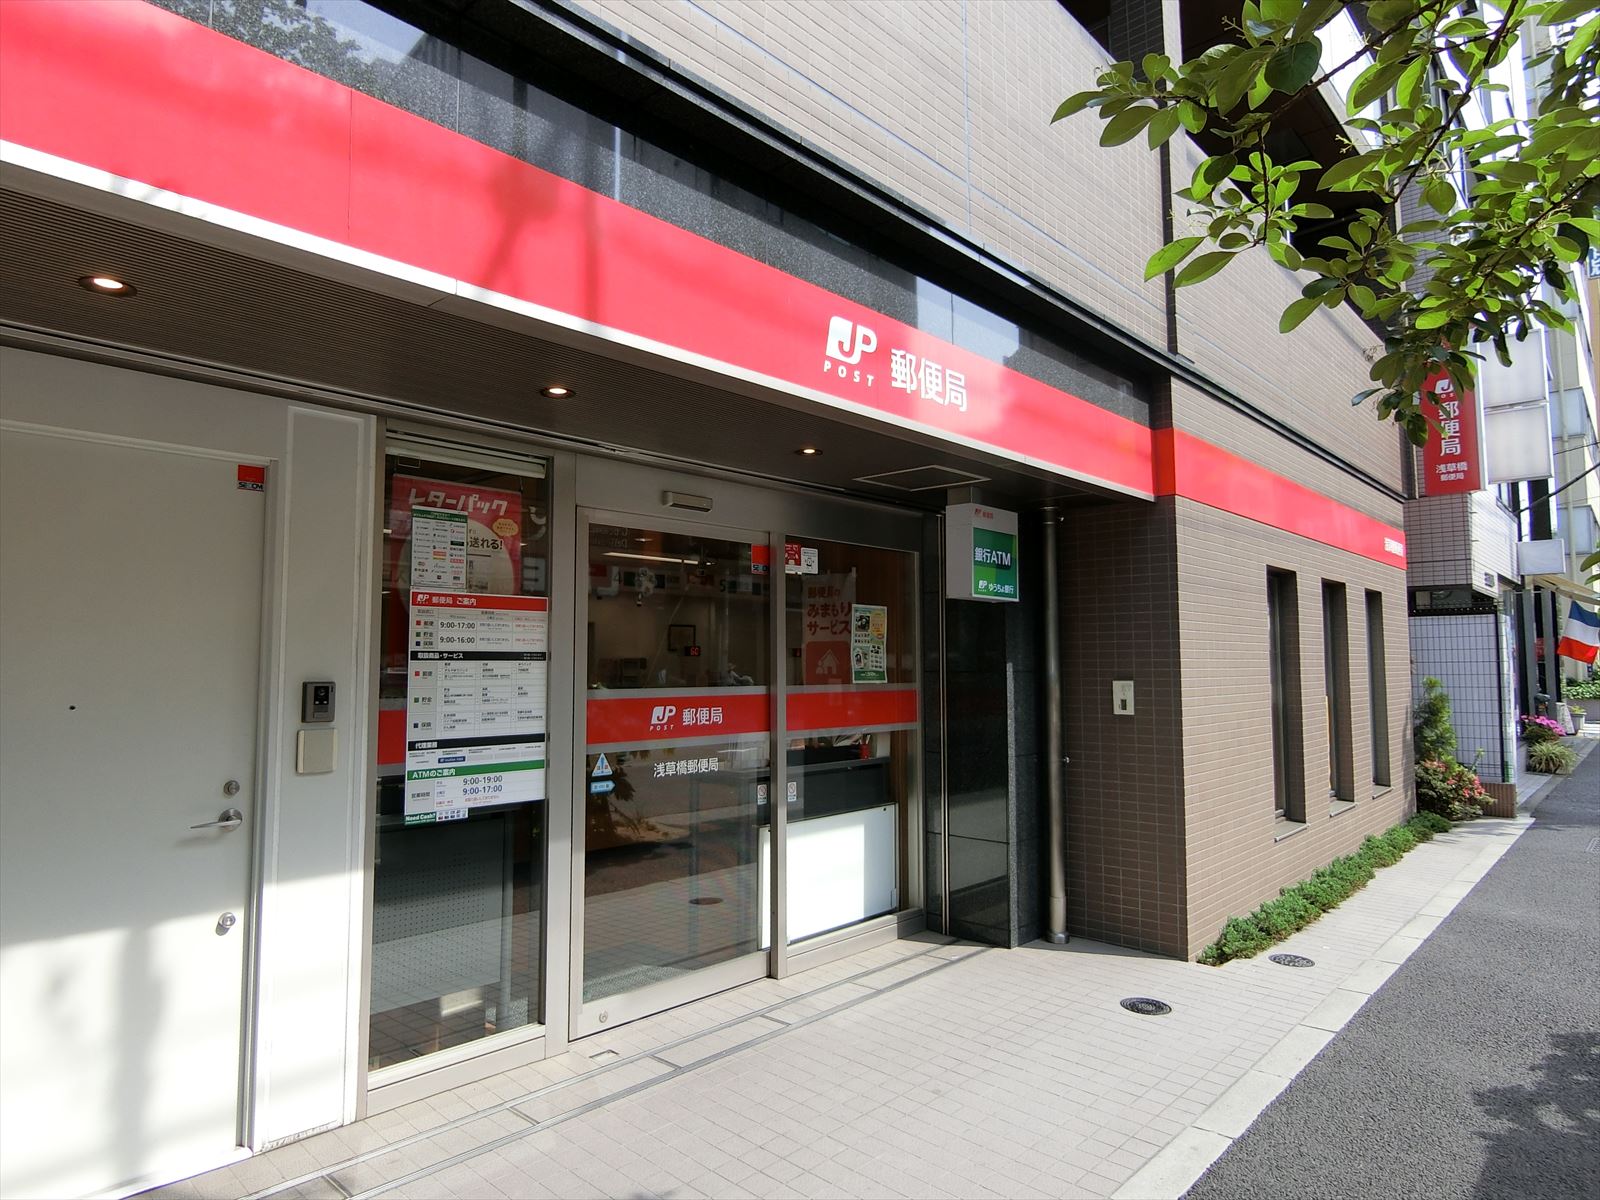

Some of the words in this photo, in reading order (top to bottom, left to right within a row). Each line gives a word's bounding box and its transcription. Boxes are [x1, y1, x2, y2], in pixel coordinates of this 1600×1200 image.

[825, 315, 878, 365] JP
[890, 348, 968, 412] 郵便局
[823, 360, 875, 387] POST
[408, 487, 508, 516] レターパック
[467, 536, 503, 550] 送れる!
[974, 546, 1011, 567] 銀行ATM
[988, 583, 1014, 594] ゆうちょ銀行
[807, 601, 852, 618] みまもり
[440, 621, 476, 630] 9:00-17:00
[807, 619, 851, 636] サービス
[440, 636, 475, 644] 9:00-16:00
[650, 705, 676, 724] JP
[682, 707, 723, 726] 郵便局
[649, 724, 675, 732] POST
[412, 768, 456, 780] ATMのご案内
[653, 757, 719, 778] 浅草橋郵便局
[463, 775, 503, 786] 9:00-19:00
[462, 785, 503, 796] 9:00-17:00
